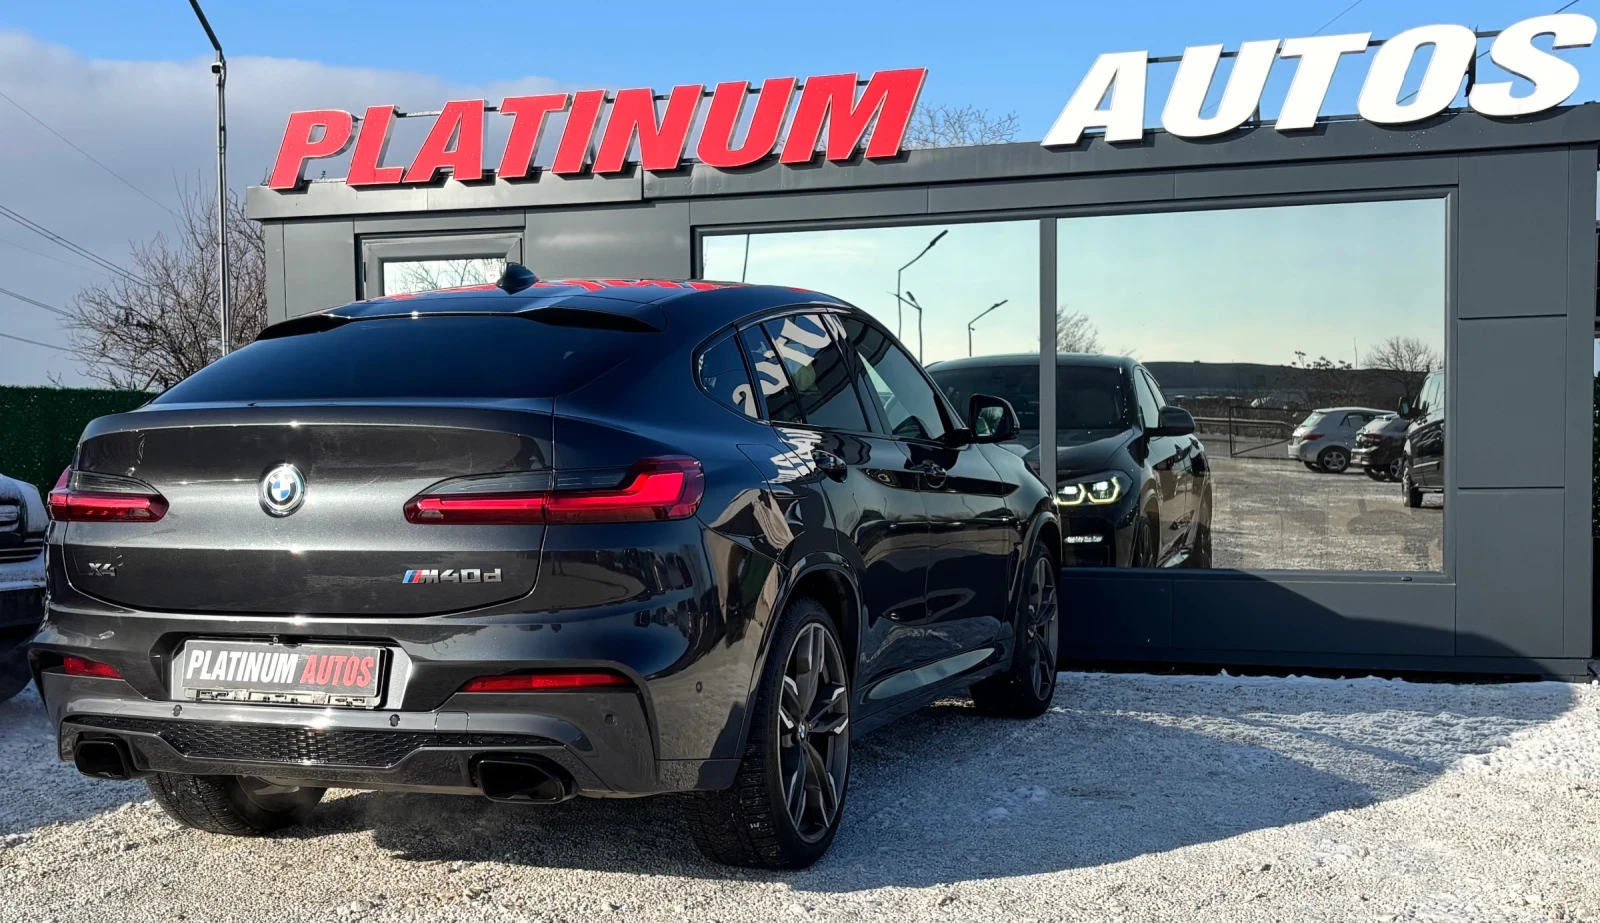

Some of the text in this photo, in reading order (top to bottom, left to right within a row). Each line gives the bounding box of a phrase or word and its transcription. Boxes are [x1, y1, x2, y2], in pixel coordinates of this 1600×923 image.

[267, 13, 1599, 190] PLATINUM AUTOS
[88, 562, 116, 577] X4
[416, 568, 502, 584] M40d
[186, 649, 375, 688] PLATINUM AUTOS
